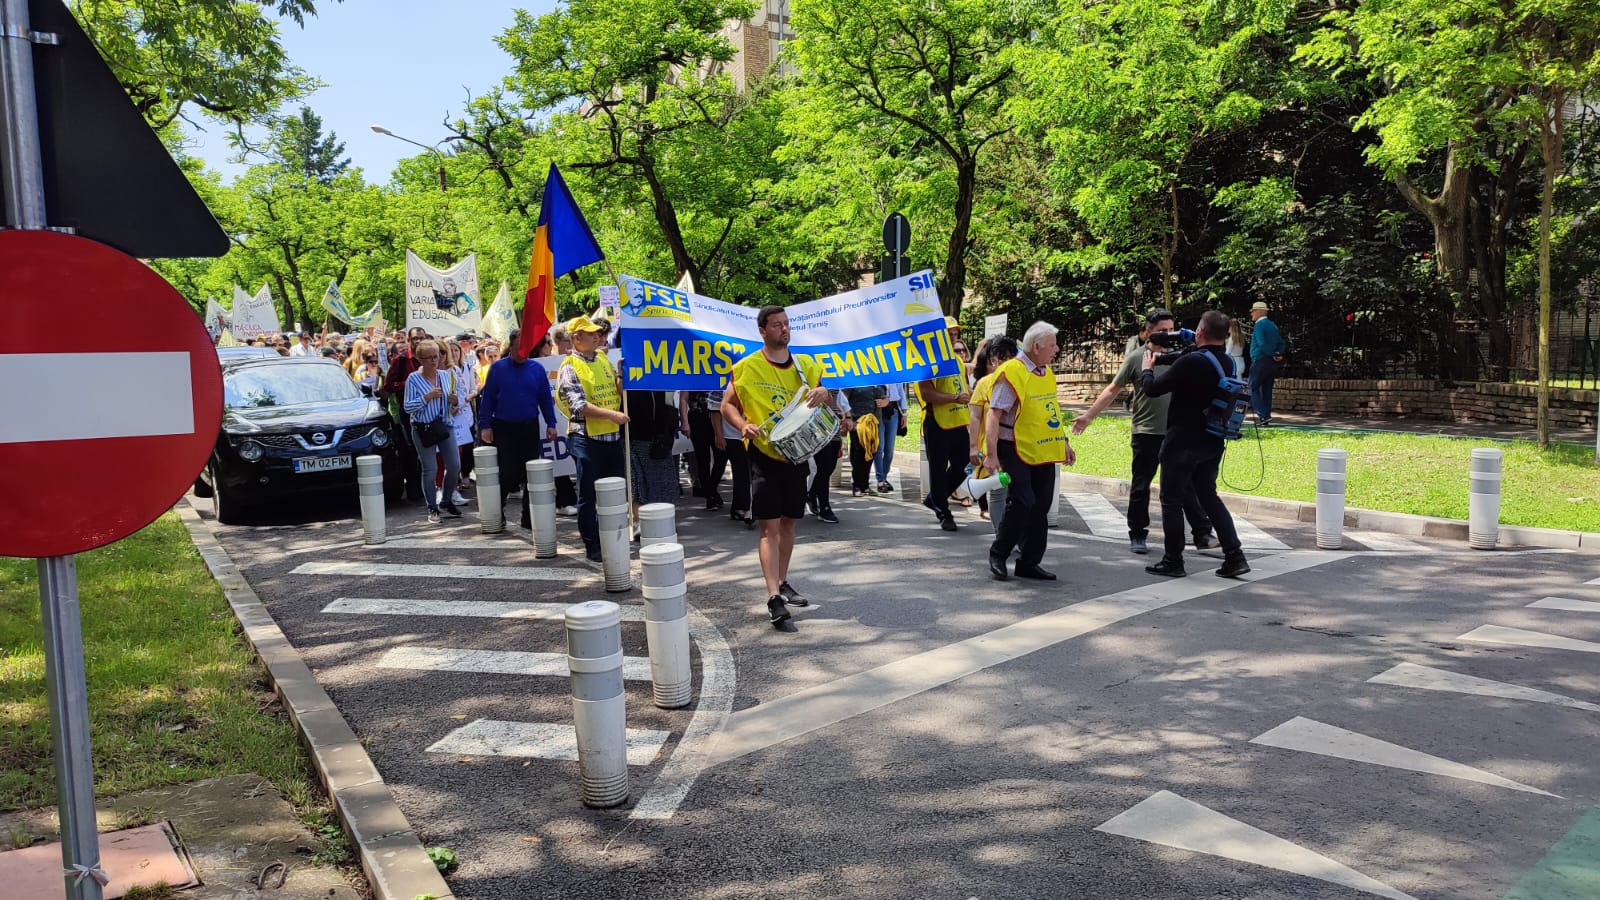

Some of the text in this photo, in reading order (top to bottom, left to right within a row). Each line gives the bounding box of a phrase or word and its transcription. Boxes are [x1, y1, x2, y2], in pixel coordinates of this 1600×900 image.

[643, 284, 690, 312] FSE
[788, 306, 842, 322] nvățământului
[843, 291, 897, 311] Preuniversitar
[302, 457, 349, 469] TM 02 FIM
